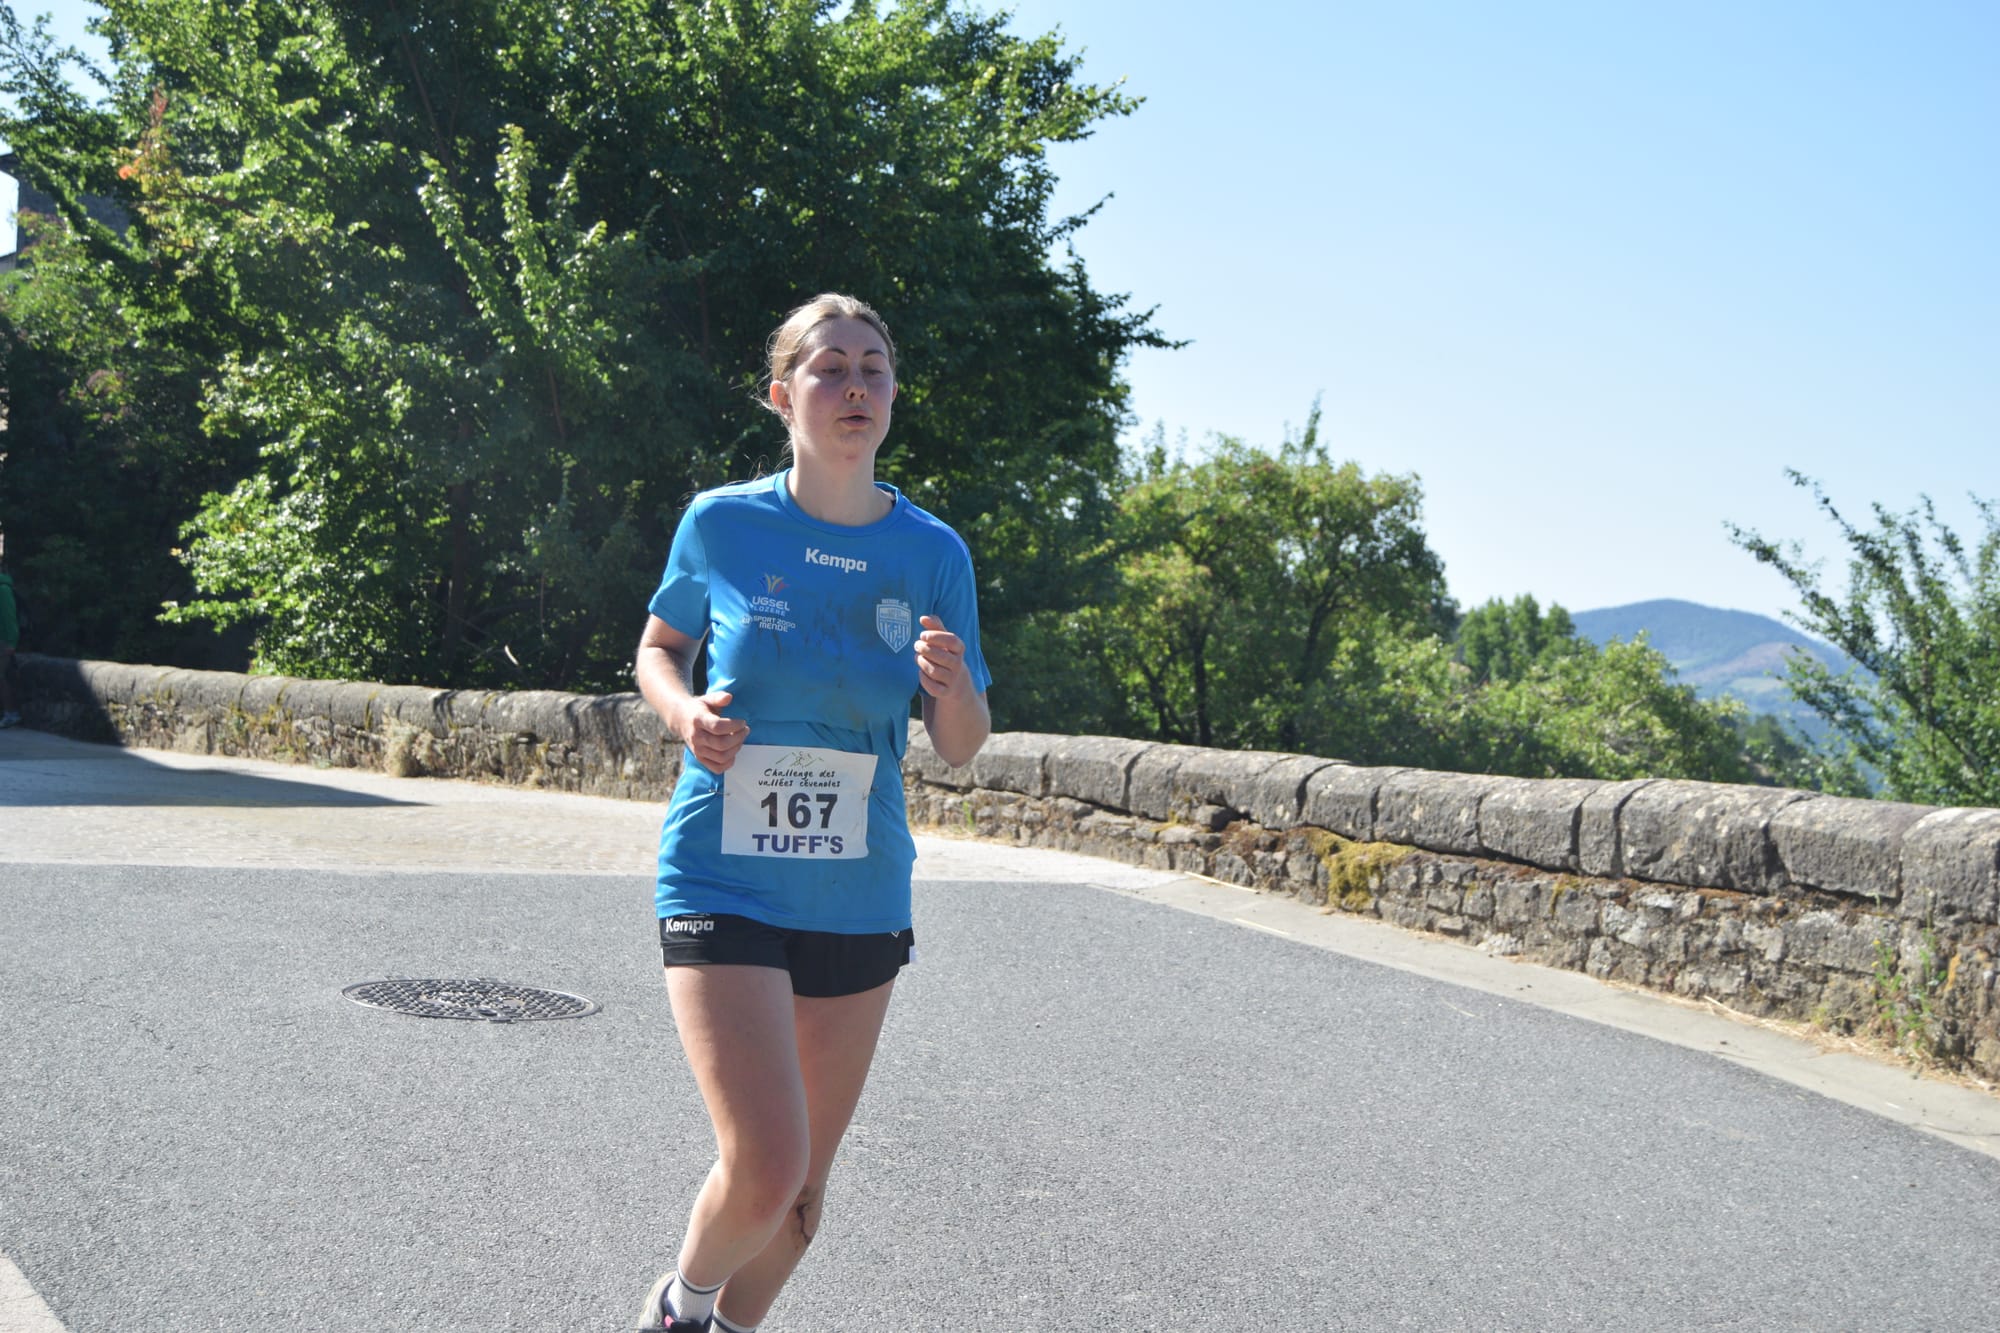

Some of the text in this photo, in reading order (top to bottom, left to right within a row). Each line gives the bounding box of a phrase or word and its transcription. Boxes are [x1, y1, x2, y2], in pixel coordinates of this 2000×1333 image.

[805, 547, 867, 573] Kempa
[752, 595, 790, 611] UGSEL
[764, 768, 836, 780] Challenge des
[761, 791, 838, 829] 167
[752, 833, 844, 855] TUFF'S
[665, 917, 715, 935] Kempa
